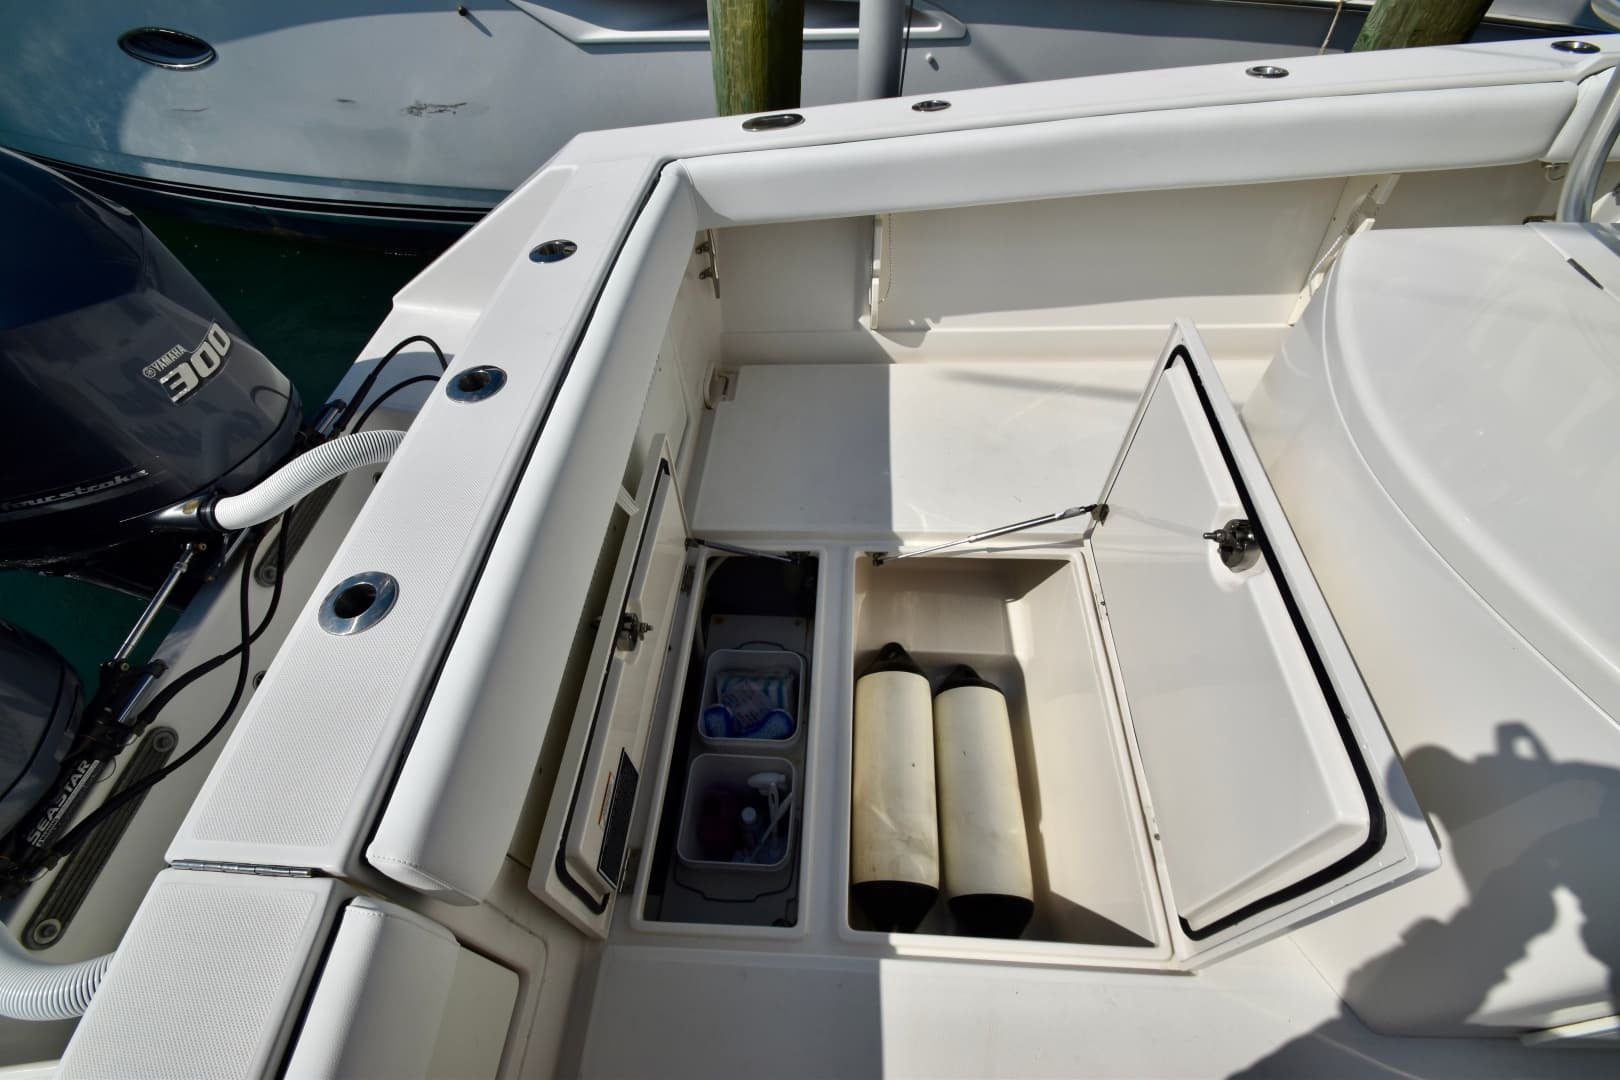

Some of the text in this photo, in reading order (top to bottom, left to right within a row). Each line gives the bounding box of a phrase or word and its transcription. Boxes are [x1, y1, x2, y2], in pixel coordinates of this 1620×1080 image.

[152, 344, 187, 372] YAMAHA
[159, 322, 231, 403] 300
[27, 759, 91, 846] SEASTAR
